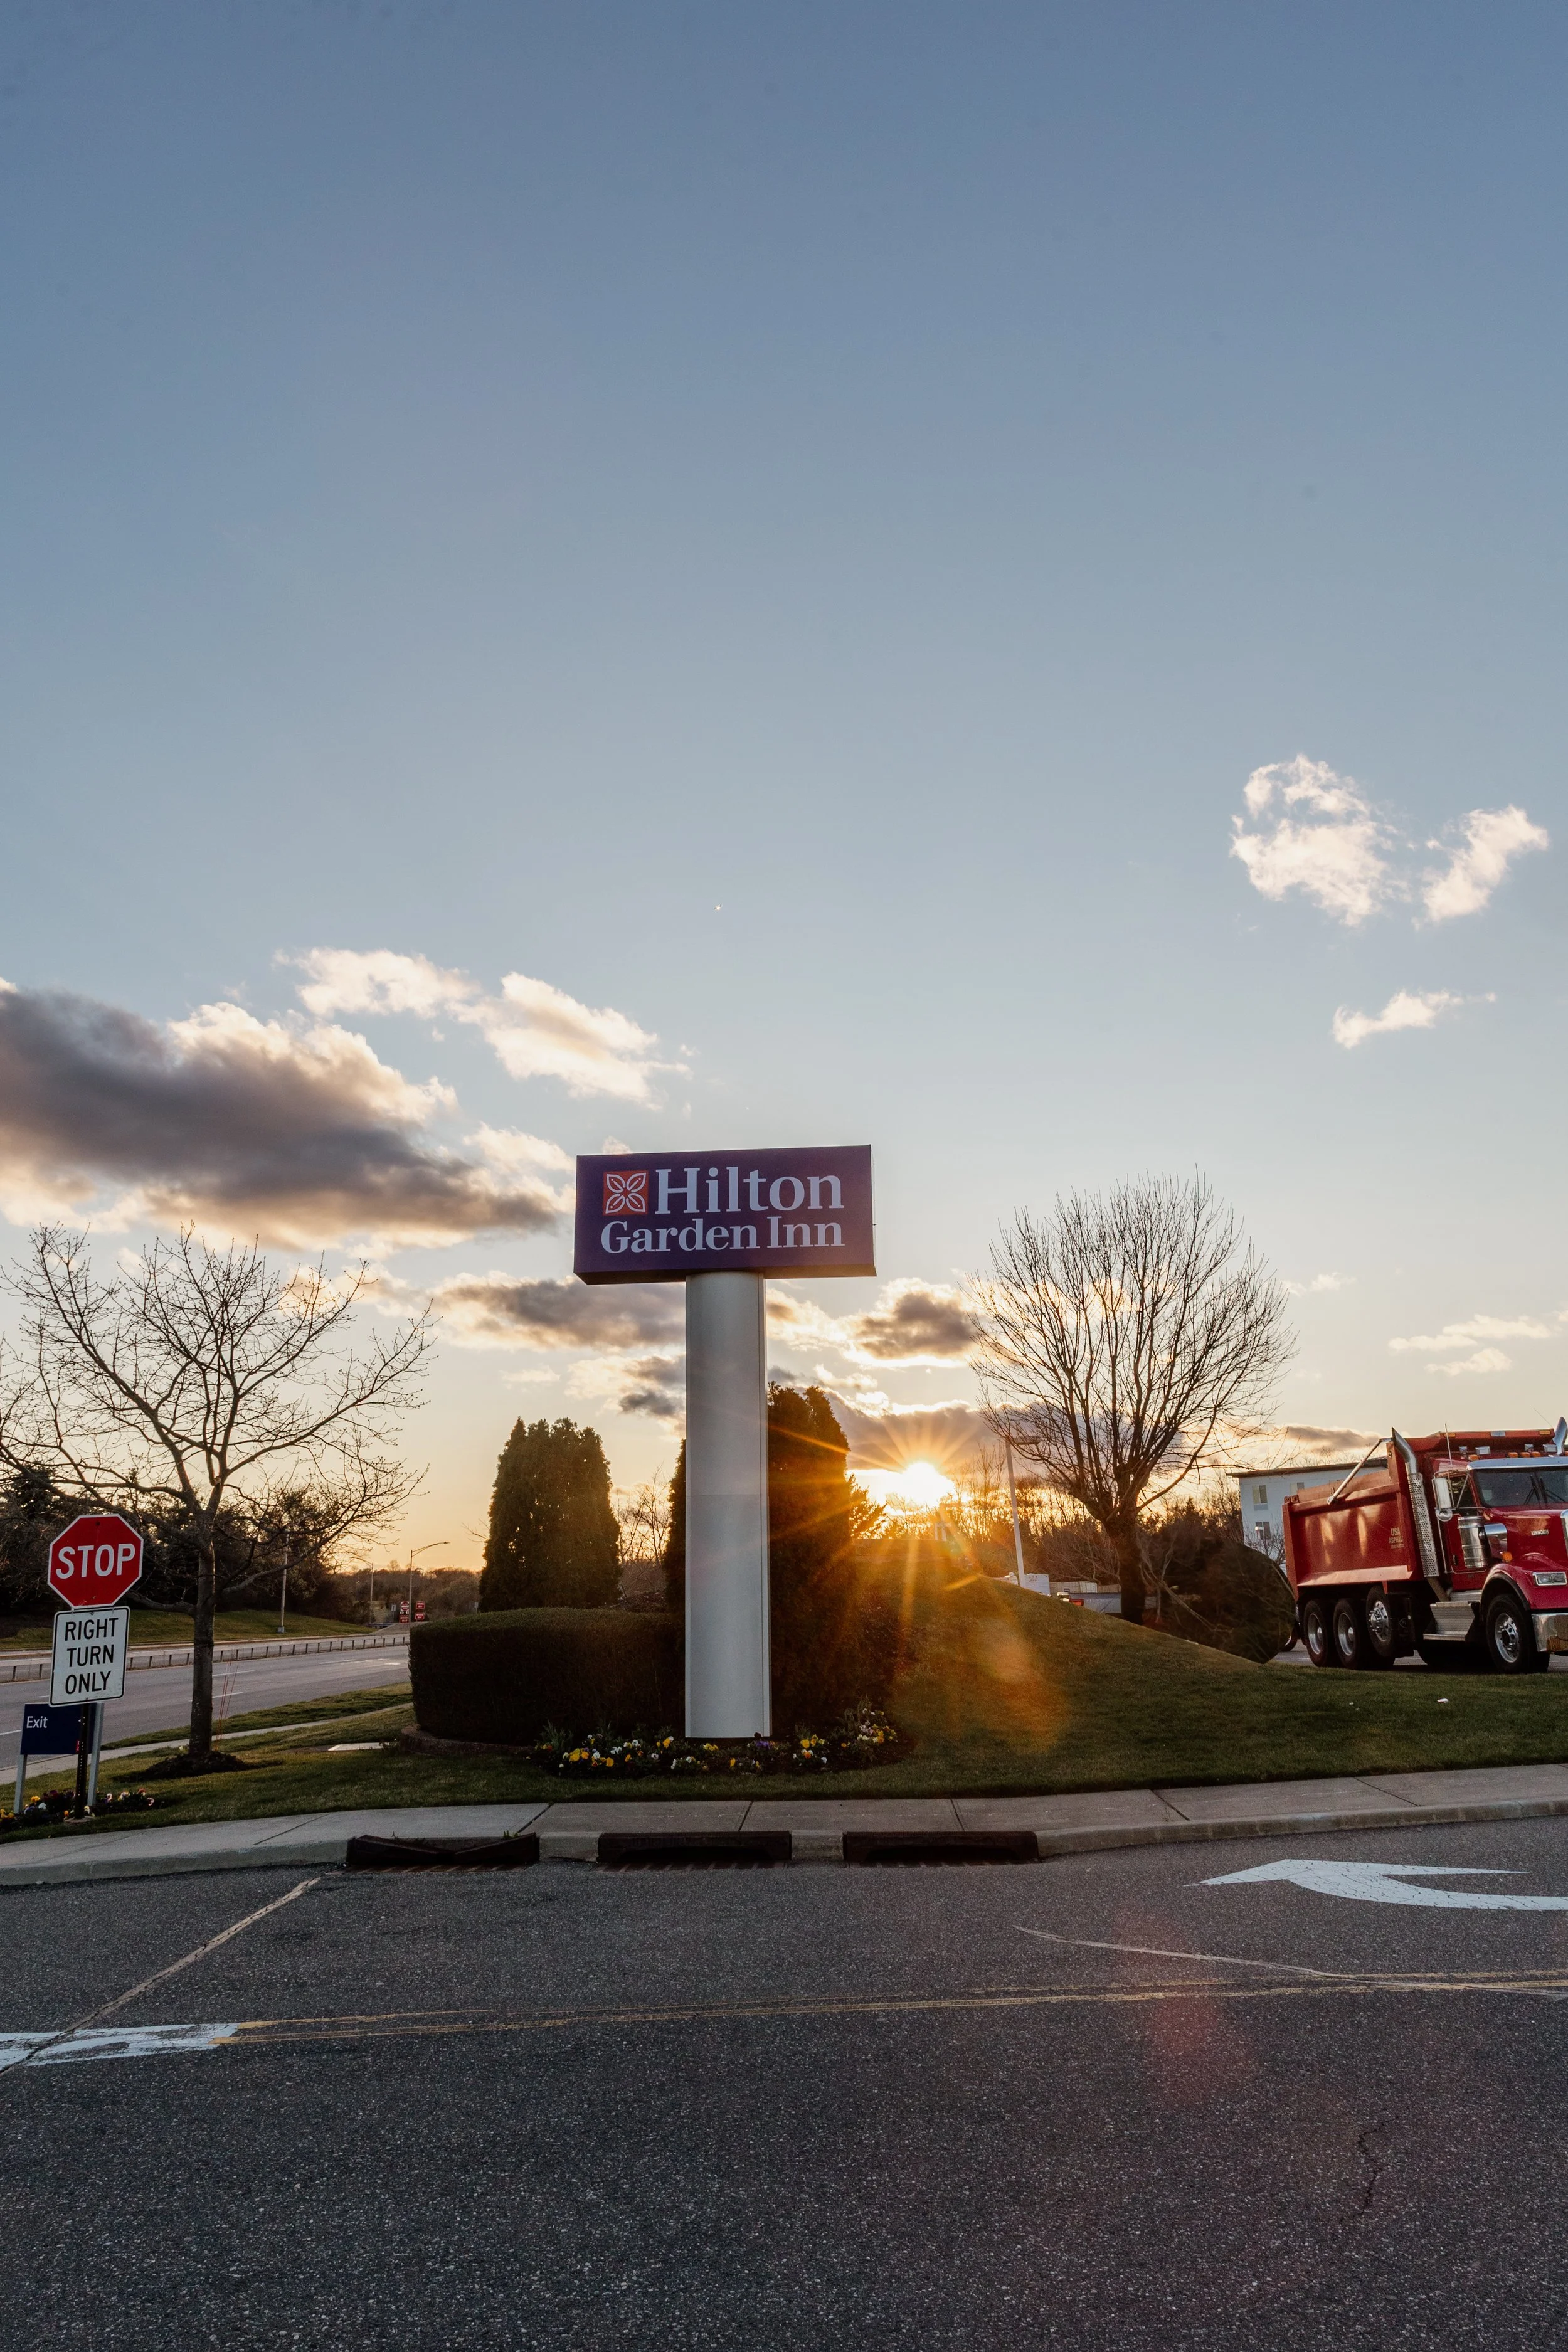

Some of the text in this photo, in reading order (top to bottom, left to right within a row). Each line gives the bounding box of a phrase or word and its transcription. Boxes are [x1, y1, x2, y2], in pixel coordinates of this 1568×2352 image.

[655, 1167, 844, 1214] Hilton
[601, 1216, 845, 1254] Garden Inn
[1390, 1527, 1401, 1536] USA
[56, 1544, 135, 1579] STOP
[65, 1618, 119, 1641] RIGHT
[66, 1644, 114, 1668] TURN
[65, 1671, 111, 1695] ONLY
[26, 1715, 48, 1728] Exit
